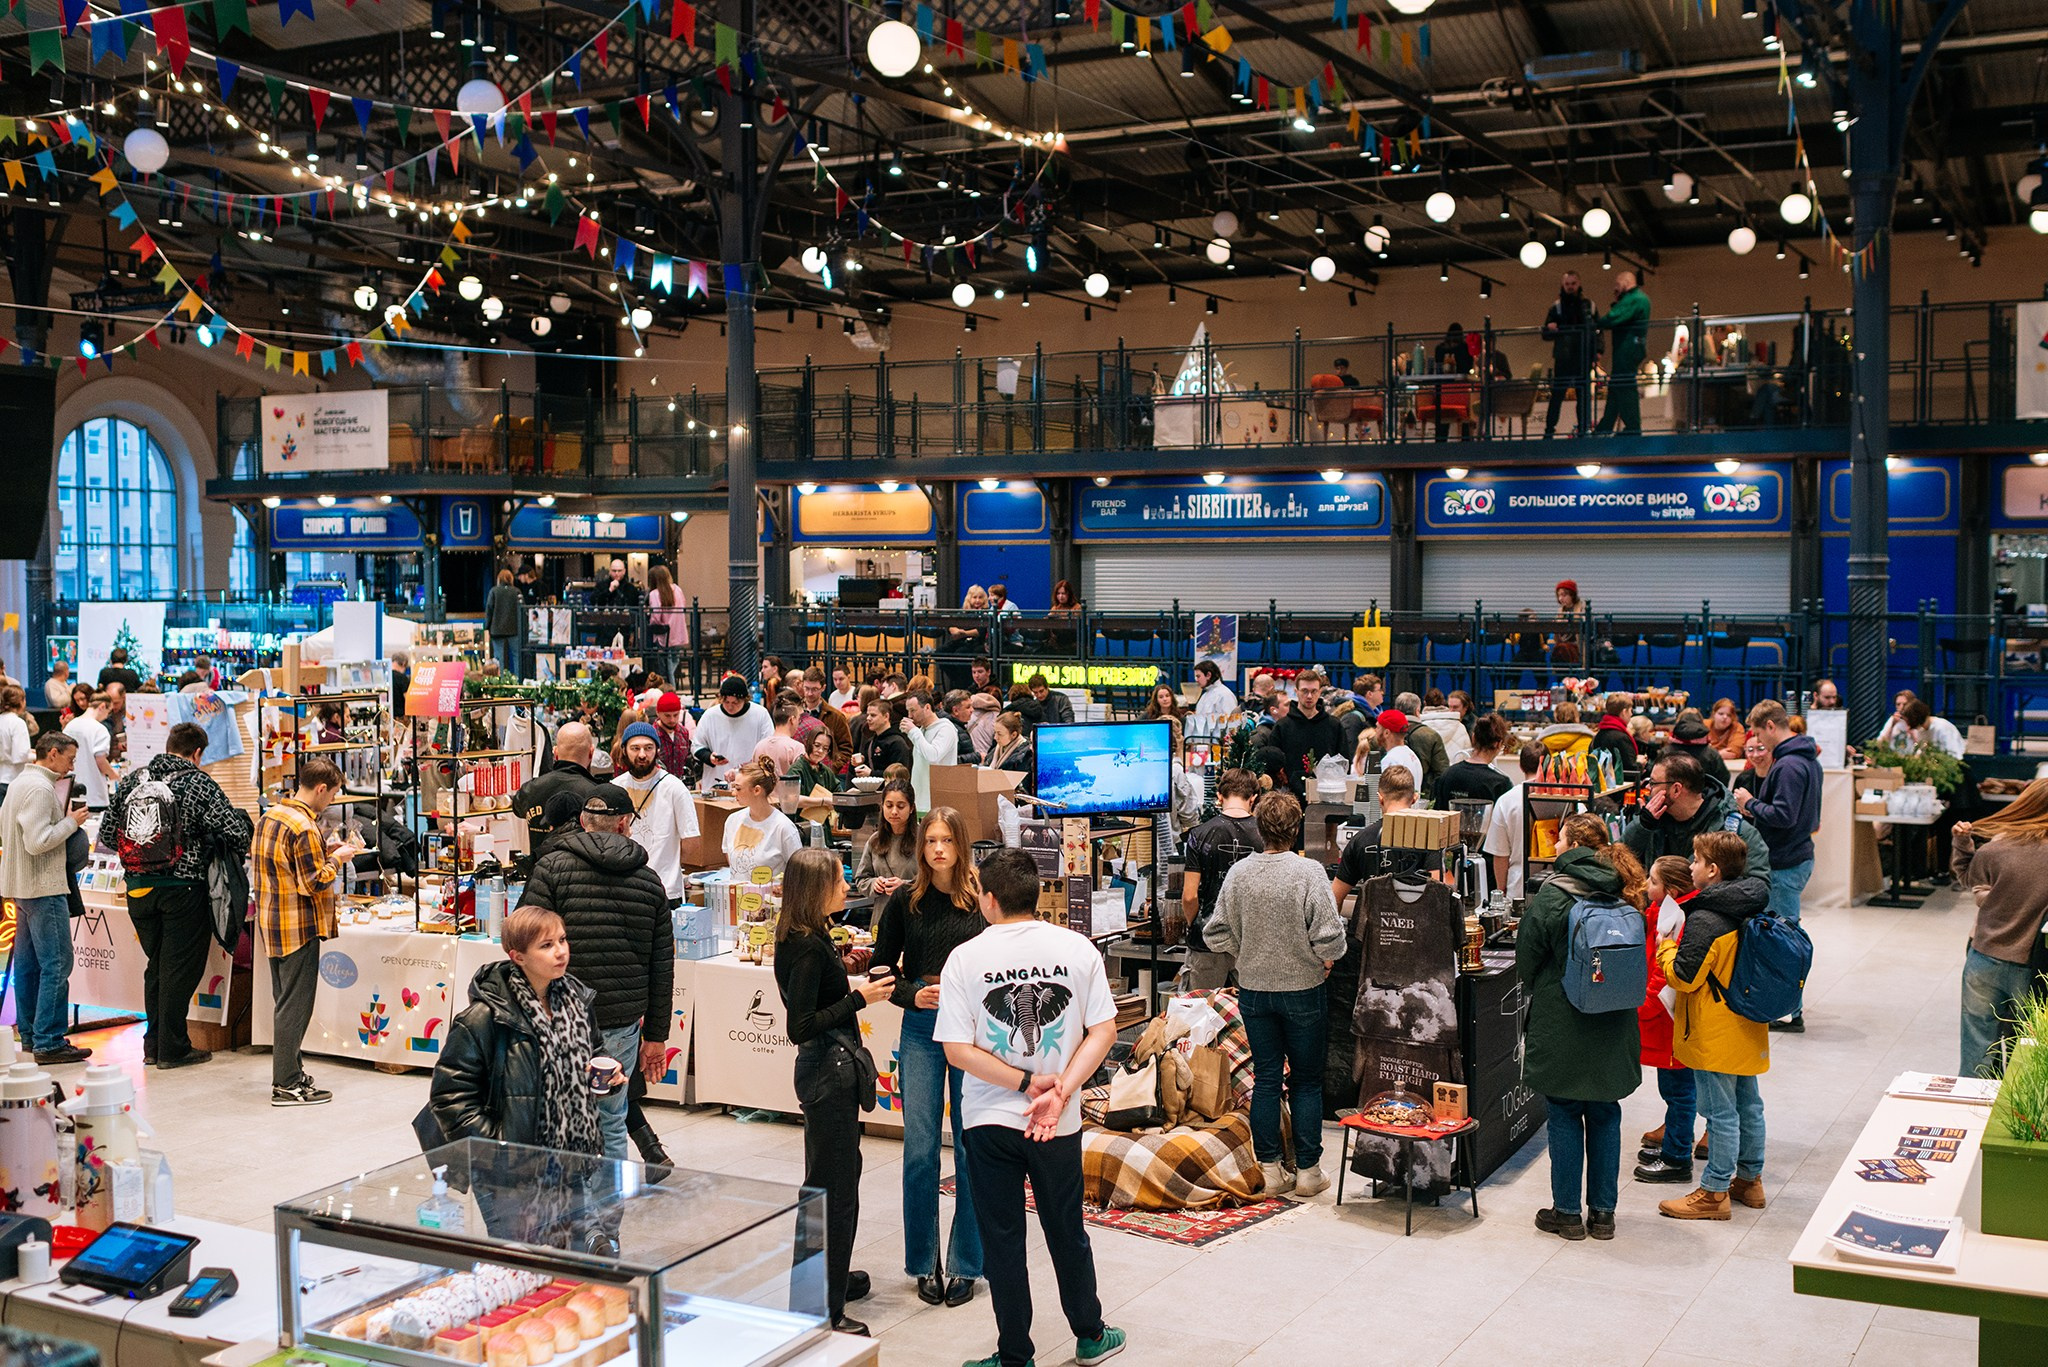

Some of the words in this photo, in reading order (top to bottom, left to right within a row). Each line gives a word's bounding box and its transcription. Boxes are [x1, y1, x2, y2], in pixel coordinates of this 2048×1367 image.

[1091, 499, 1126, 508] FRIENDS
[1187, 493, 1262, 519] SIBBITTER
[1318, 503, 1335, 512] ДЛЯ
[1337, 500, 1369, 511] ДРУЗЕЙ
[1334, 495, 1350, 503] БАР
[1509, 494, 1577, 507] БОЛЬШОЕ
[1580, 493, 1644, 506] РУССКОЕ
[1648, 492, 1688, 505] ВИНО
[1100, 507, 1117, 516] BAR
[1662, 506, 1696, 519] simple
[1061, 665, 1086, 686] ЭТО
[1088, 665, 1159, 687] ПРИВЕЗЛИ?
[1380, 917, 1415, 929] NAEB
[74, 946, 115, 960] MACONDO
[78, 956, 110, 970] COFFEE
[381, 955, 401, 965] OPEN
[402, 956, 430, 968] COFFEE
[984, 964, 1068, 983] SANGALAI
[728, 1029, 795, 1048] COOKUSHK
[752, 1045, 775, 1054] coffee
[1380, 1056, 1401, 1064] TOGGLE
[1401, 1059, 1424, 1068] COFFEE
[1380, 1062, 1410, 1074] ROAST
[1411, 1068, 1440, 1081] HARD
[1380, 1071, 1396, 1081] FLY
[1397, 1075, 1423, 1086] HIGH
[1509, 1113, 1528, 1141] COFFEE
